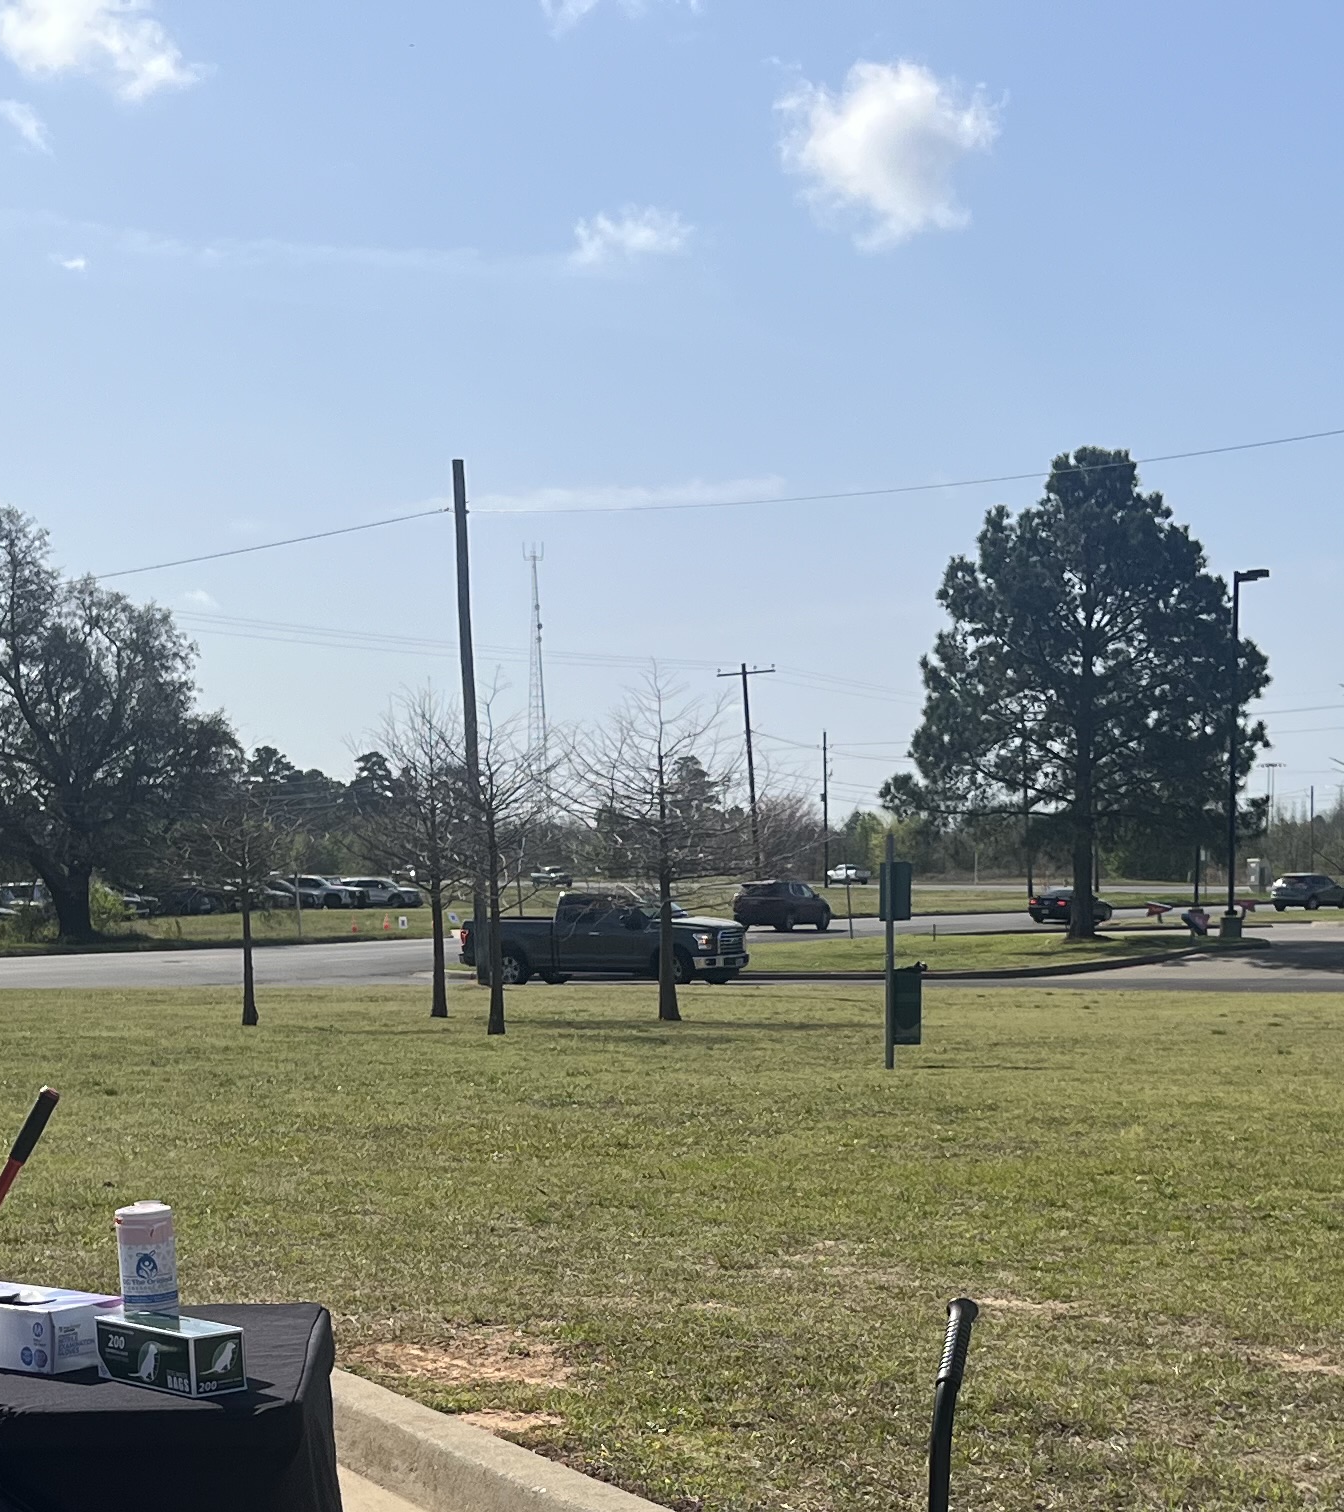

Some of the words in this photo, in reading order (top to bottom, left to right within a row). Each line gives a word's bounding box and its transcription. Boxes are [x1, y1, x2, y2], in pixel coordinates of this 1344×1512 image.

[108, 1334, 125, 1350] 200
[166, 1375, 190, 1393] BAGS
[198, 1380, 218, 1392] 200
